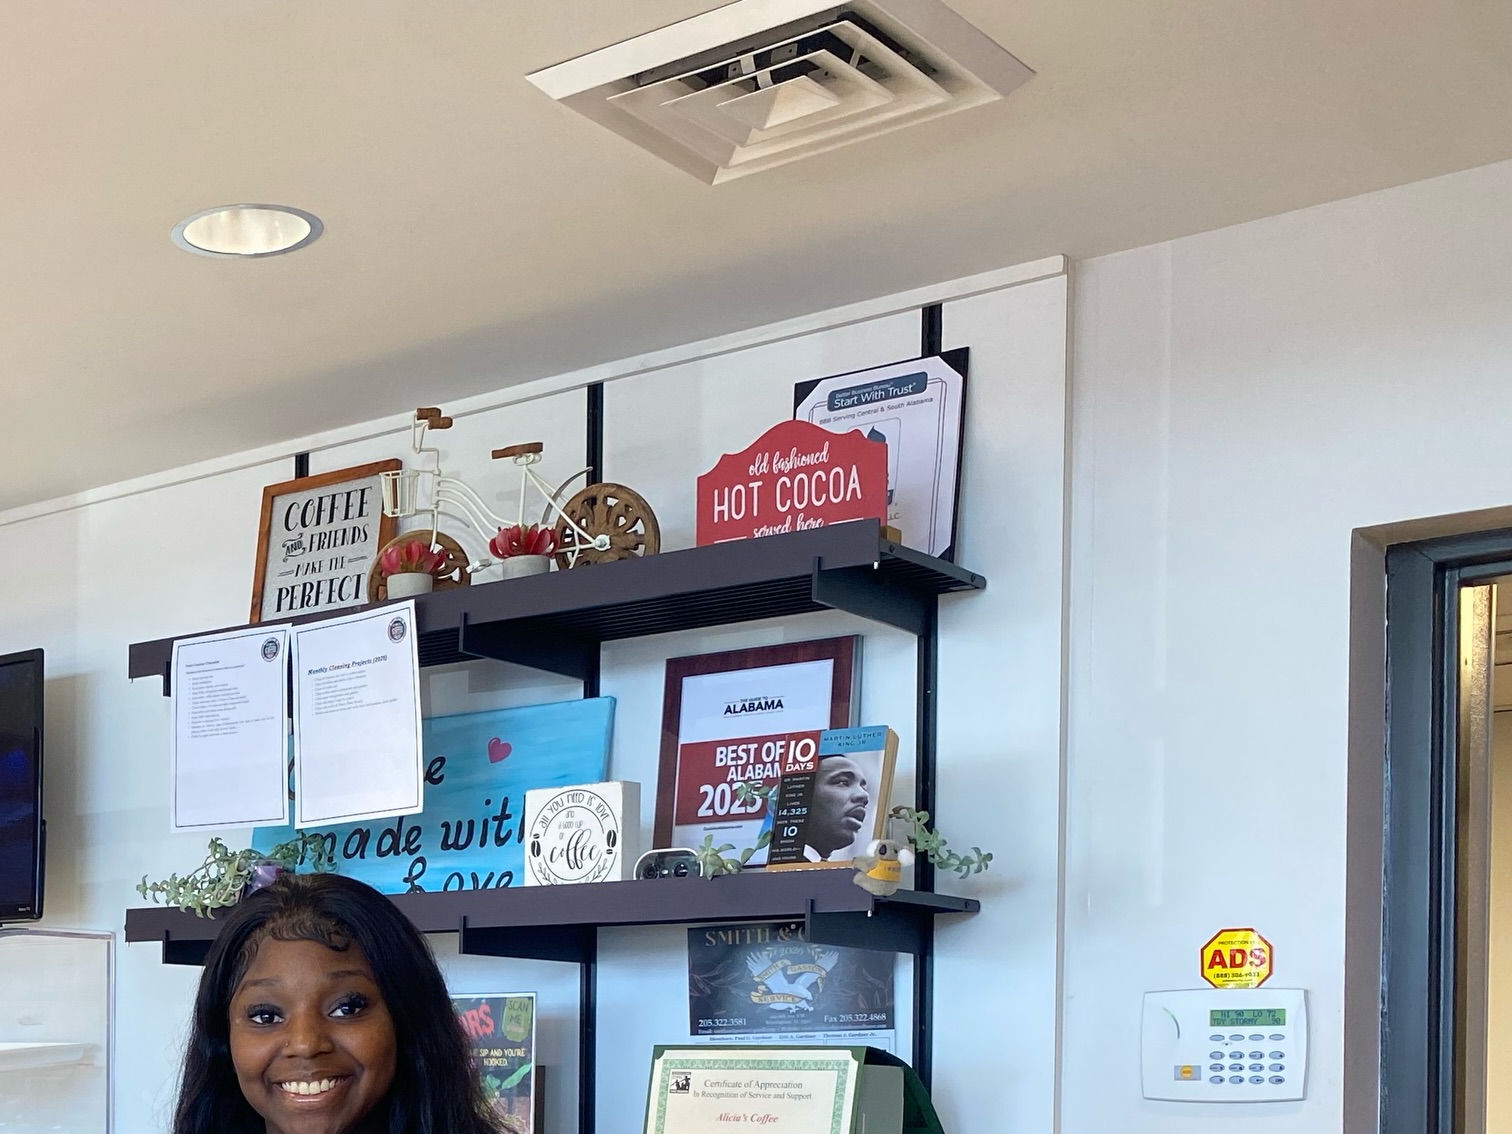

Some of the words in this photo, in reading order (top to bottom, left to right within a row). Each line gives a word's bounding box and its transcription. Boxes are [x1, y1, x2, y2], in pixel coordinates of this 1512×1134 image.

[834, 396, 858, 408] Start
[861, 390, 885, 402] With
[833, 413, 856, 424] Serving
[857, 407, 879, 416] Central
[887, 402, 905, 411] South
[906, 397, 934, 406] Alabama
[748, 453, 769, 476] old
[772, 441, 830, 474] fashioned
[714, 481, 763, 523] HOT
[776, 465, 862, 513] COCOA
[284, 486, 372, 532] COFFEE
[753, 513, 792, 539] served
[796, 515, 825, 532] here
[308, 524, 370, 553] FRIENDS
[294, 559, 323, 577] MAKE
[328, 556, 346, 571] THE
[275, 573, 366, 613] PERFECT
[307, 667, 328, 676] Monthly
[329, 662, 351, 671] Cleaning
[351, 658, 372, 667] Projects
[723, 699, 784, 715] ALABAMA
[853, 732, 882, 740] LUTHER
[715, 743, 758, 767] BEST
[761, 740, 785, 762] OF
[787, 738, 816, 763] 10
[786, 762, 814, 772] DAYS
[778, 808, 807, 816] 14,325
[783, 826, 798, 837] 10
[550, 828, 601, 870] coffee
[705, 928, 770, 946] SMITH
[777, 925, 793, 943] &
[1207, 948, 1266, 970] ADS
[508, 1001, 528, 1013] SCAN
[509, 1014, 522, 1025] ME
[698, 1018, 747, 1028] 205.322.3581
[824, 1014, 837, 1023] Fax
[839, 1012, 887, 1023] 205.322.4868
[479, 1049, 489, 1057] SIP
[490, 1049, 503, 1057] AND
[503, 1048, 526, 1057] YOU'RE
[704, 1080, 742, 1089] Certificate
[745, 1080, 752, 1088] of
[754, 1080, 803, 1090] Appreciation
[701, 1091, 739, 1099] Recognition
[786, 1093, 812, 1101] Support
[716, 1113, 748, 1122] Alicia's
[750, 1113, 779, 1124] Coffee
